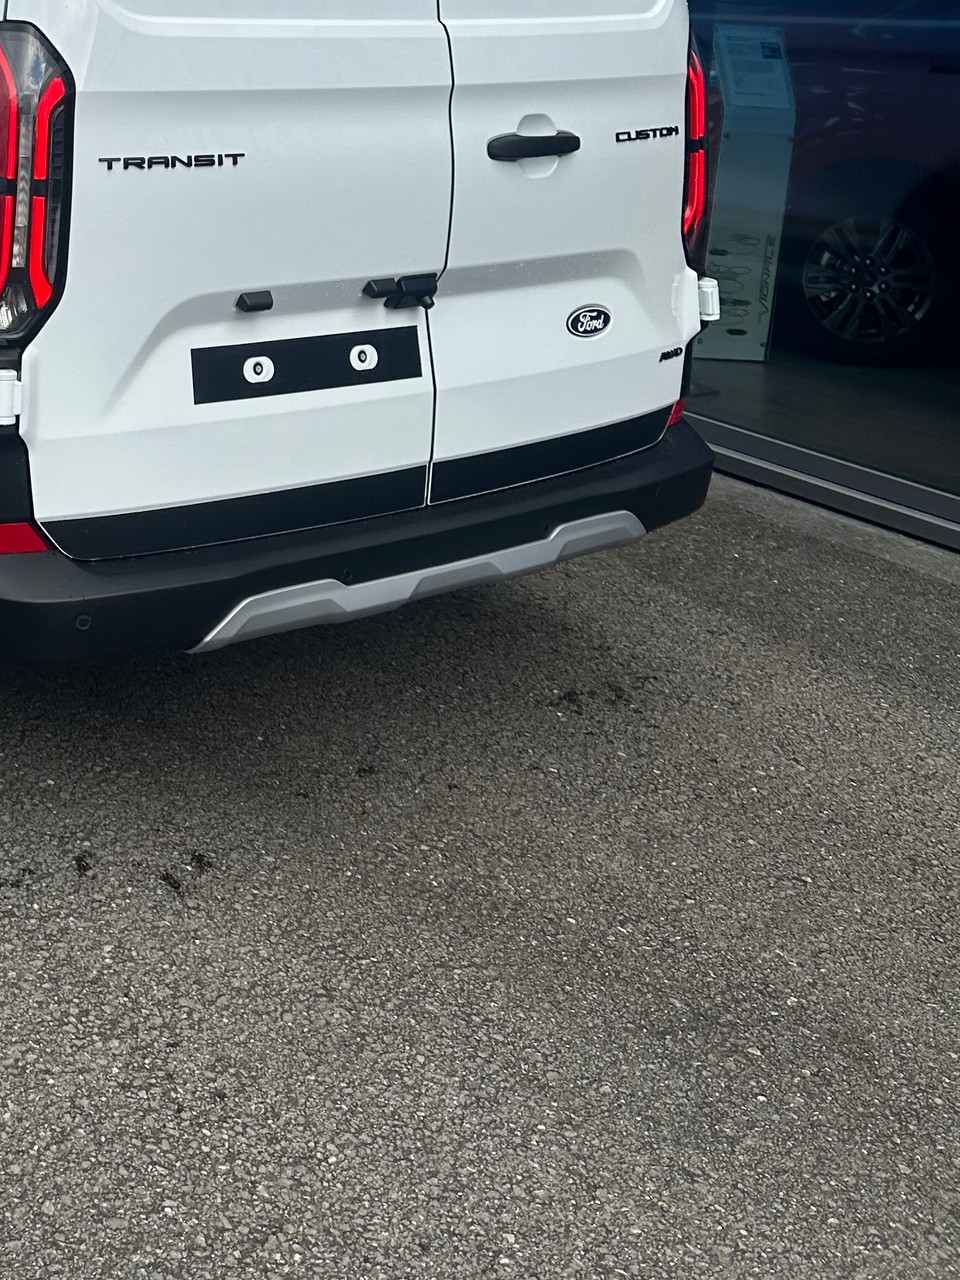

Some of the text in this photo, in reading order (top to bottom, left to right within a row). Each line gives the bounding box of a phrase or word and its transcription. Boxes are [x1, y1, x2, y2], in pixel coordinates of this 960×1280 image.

[615, 125, 680, 143] CUSTOM
[98, 153, 246, 171] TRANSIT
[577, 311, 605, 332] Ford
[658, 346, 684, 363] AWD
